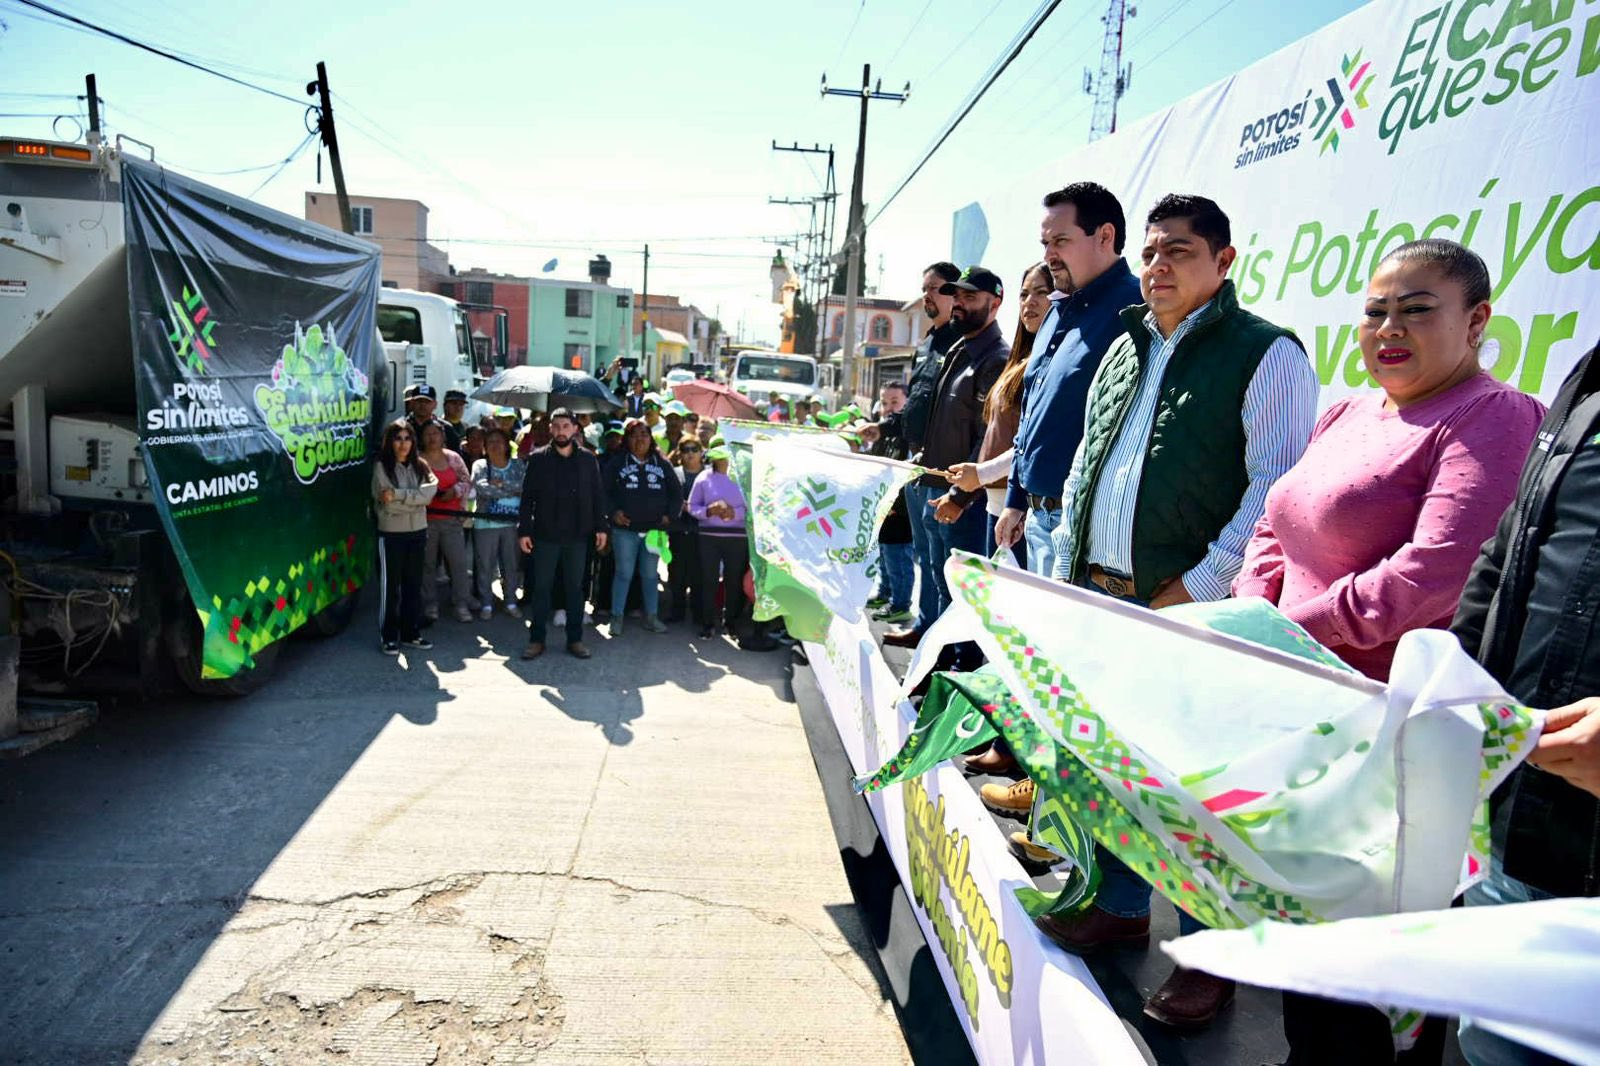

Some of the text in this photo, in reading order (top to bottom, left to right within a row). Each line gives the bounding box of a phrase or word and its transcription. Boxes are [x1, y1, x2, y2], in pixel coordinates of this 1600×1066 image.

[1446, 0, 1600, 61] CA
[1378, 58, 1486, 155] que
[1481, 27, 1572, 105] se
[1240, 88, 1313, 148] POTOSÍ
[1234, 146, 1254, 169] sin
[147, 400, 187, 430] sin
[147, 434, 192, 446] GOBIERNO
[166, 470, 259, 505] CAMINOS
